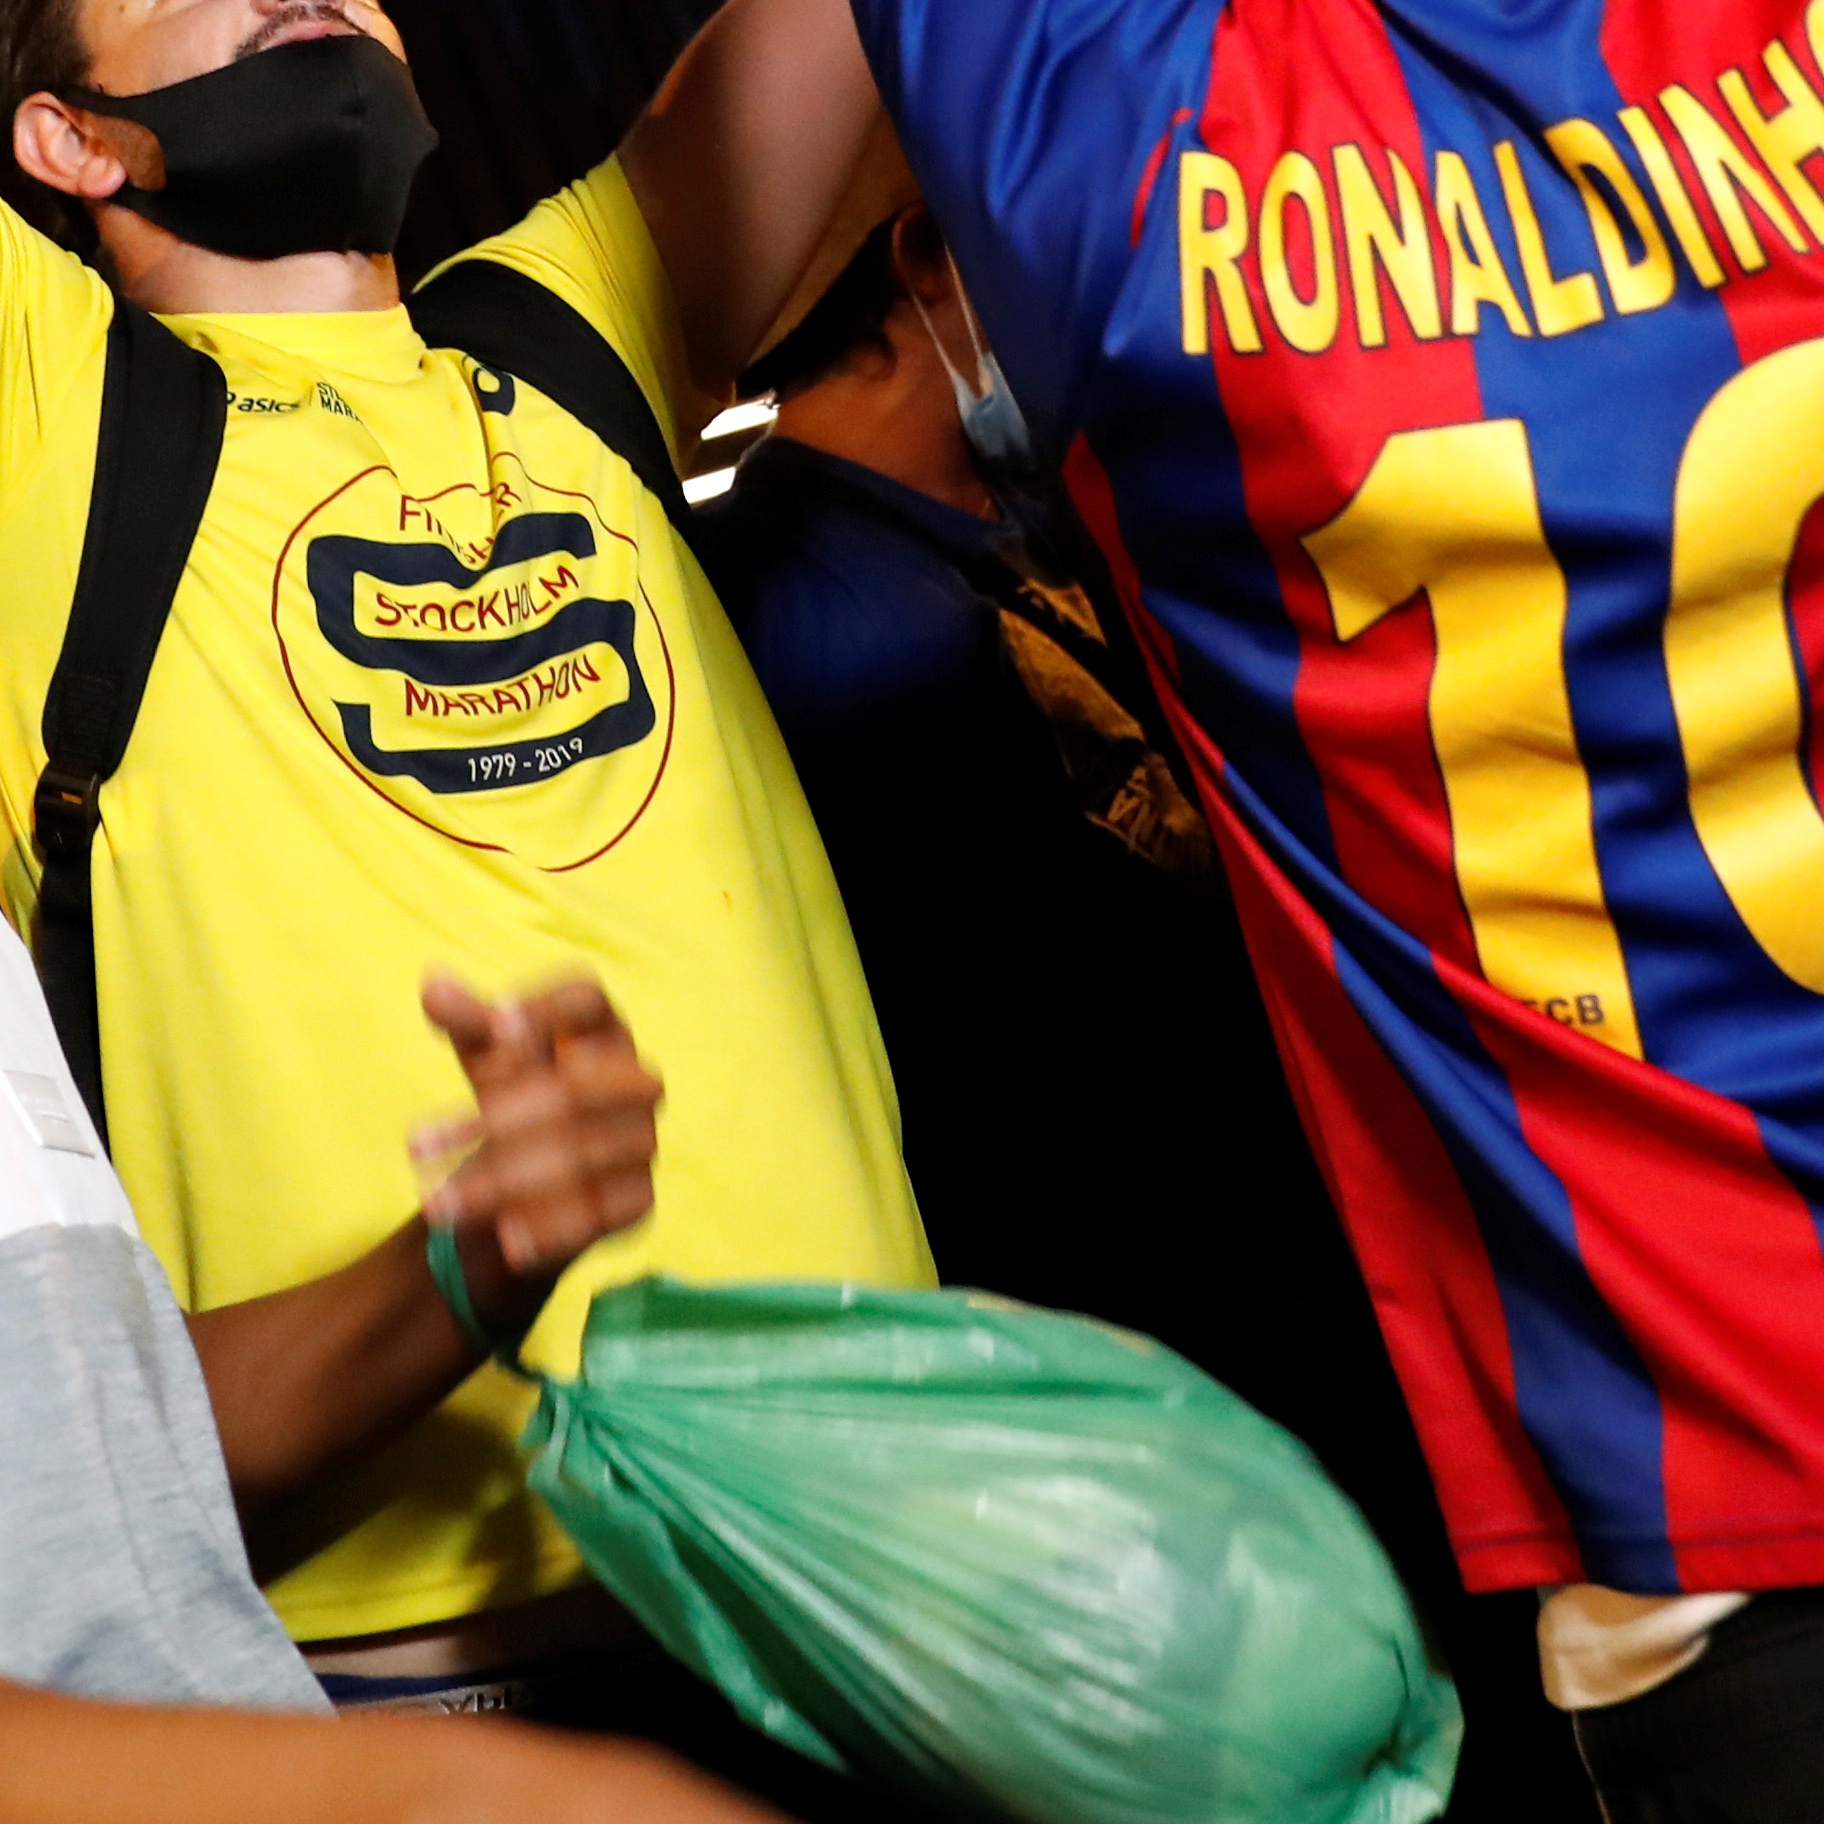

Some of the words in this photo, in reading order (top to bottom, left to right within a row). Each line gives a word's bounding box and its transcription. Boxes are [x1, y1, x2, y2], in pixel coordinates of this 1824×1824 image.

[375, 564, 580, 632] STOCKHOLM
[404, 653, 601, 717] MARATHON
[468, 752, 517, 782] 1979
[534, 736, 583, 773] 2019
